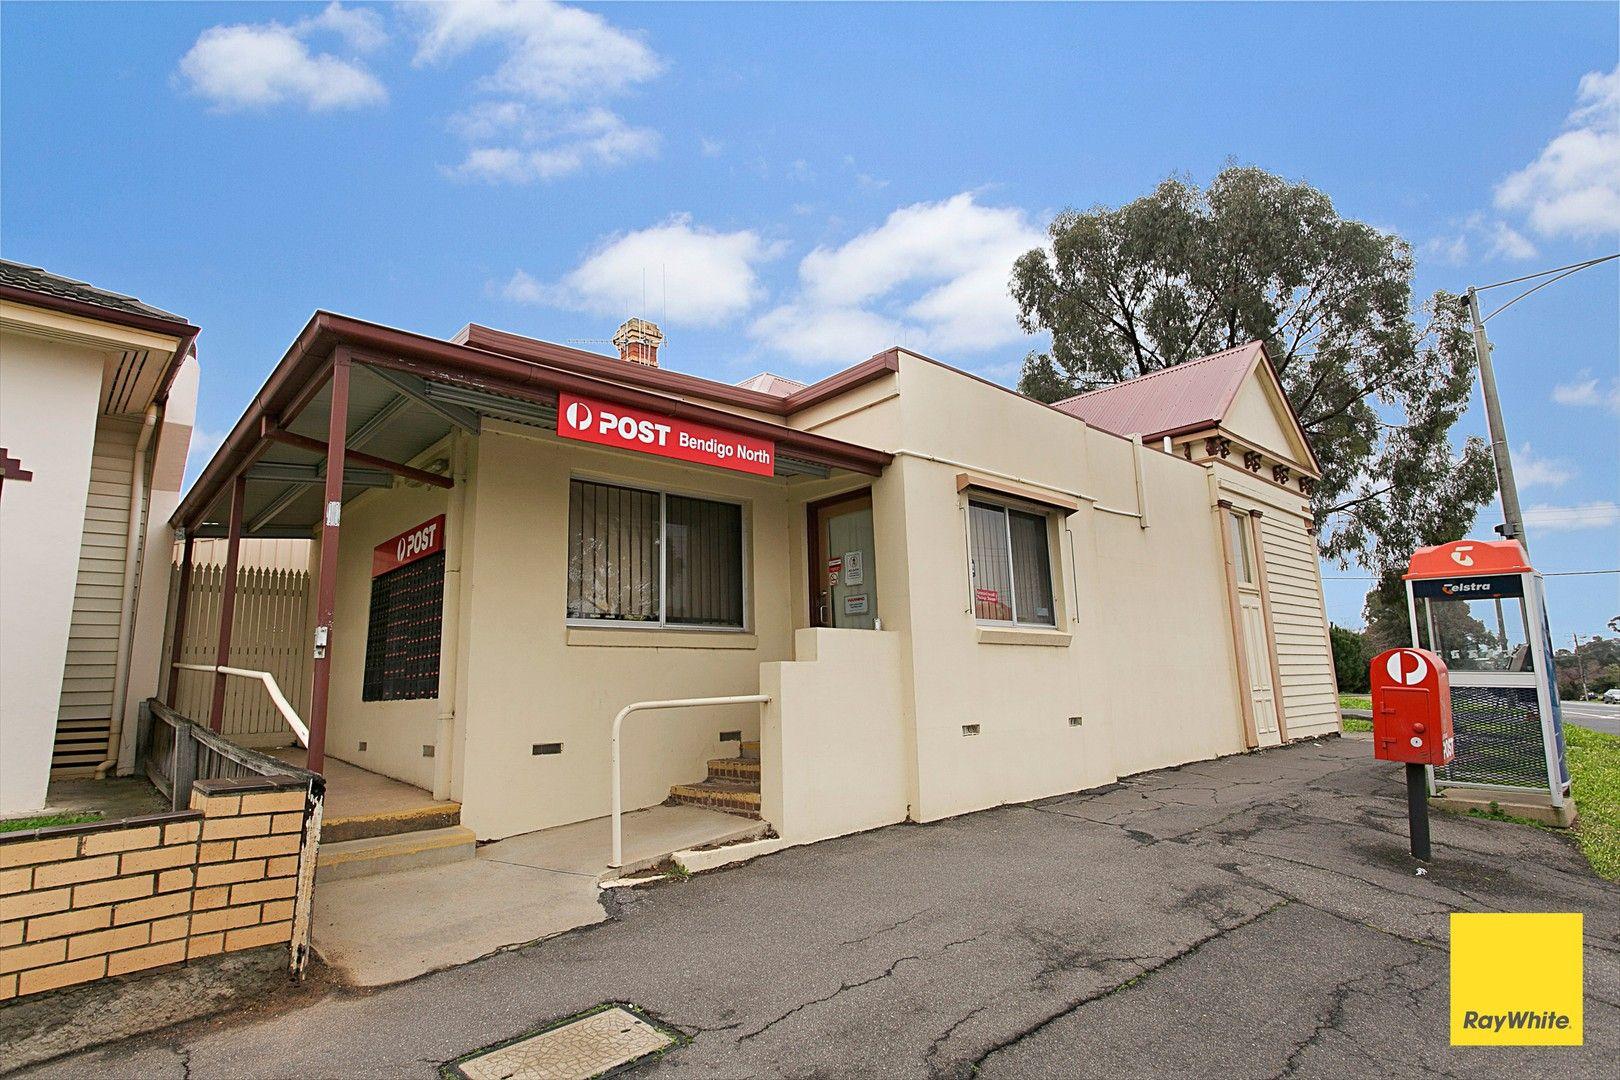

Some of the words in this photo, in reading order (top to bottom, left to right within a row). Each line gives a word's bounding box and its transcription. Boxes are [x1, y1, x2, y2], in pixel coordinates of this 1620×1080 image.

[599, 411, 671, 447] POST
[679, 432, 734, 458] Bendigo
[737, 444, 770, 464] North
[407, 523, 437, 557] POST
[1442, 582, 1491, 595] Telstra
